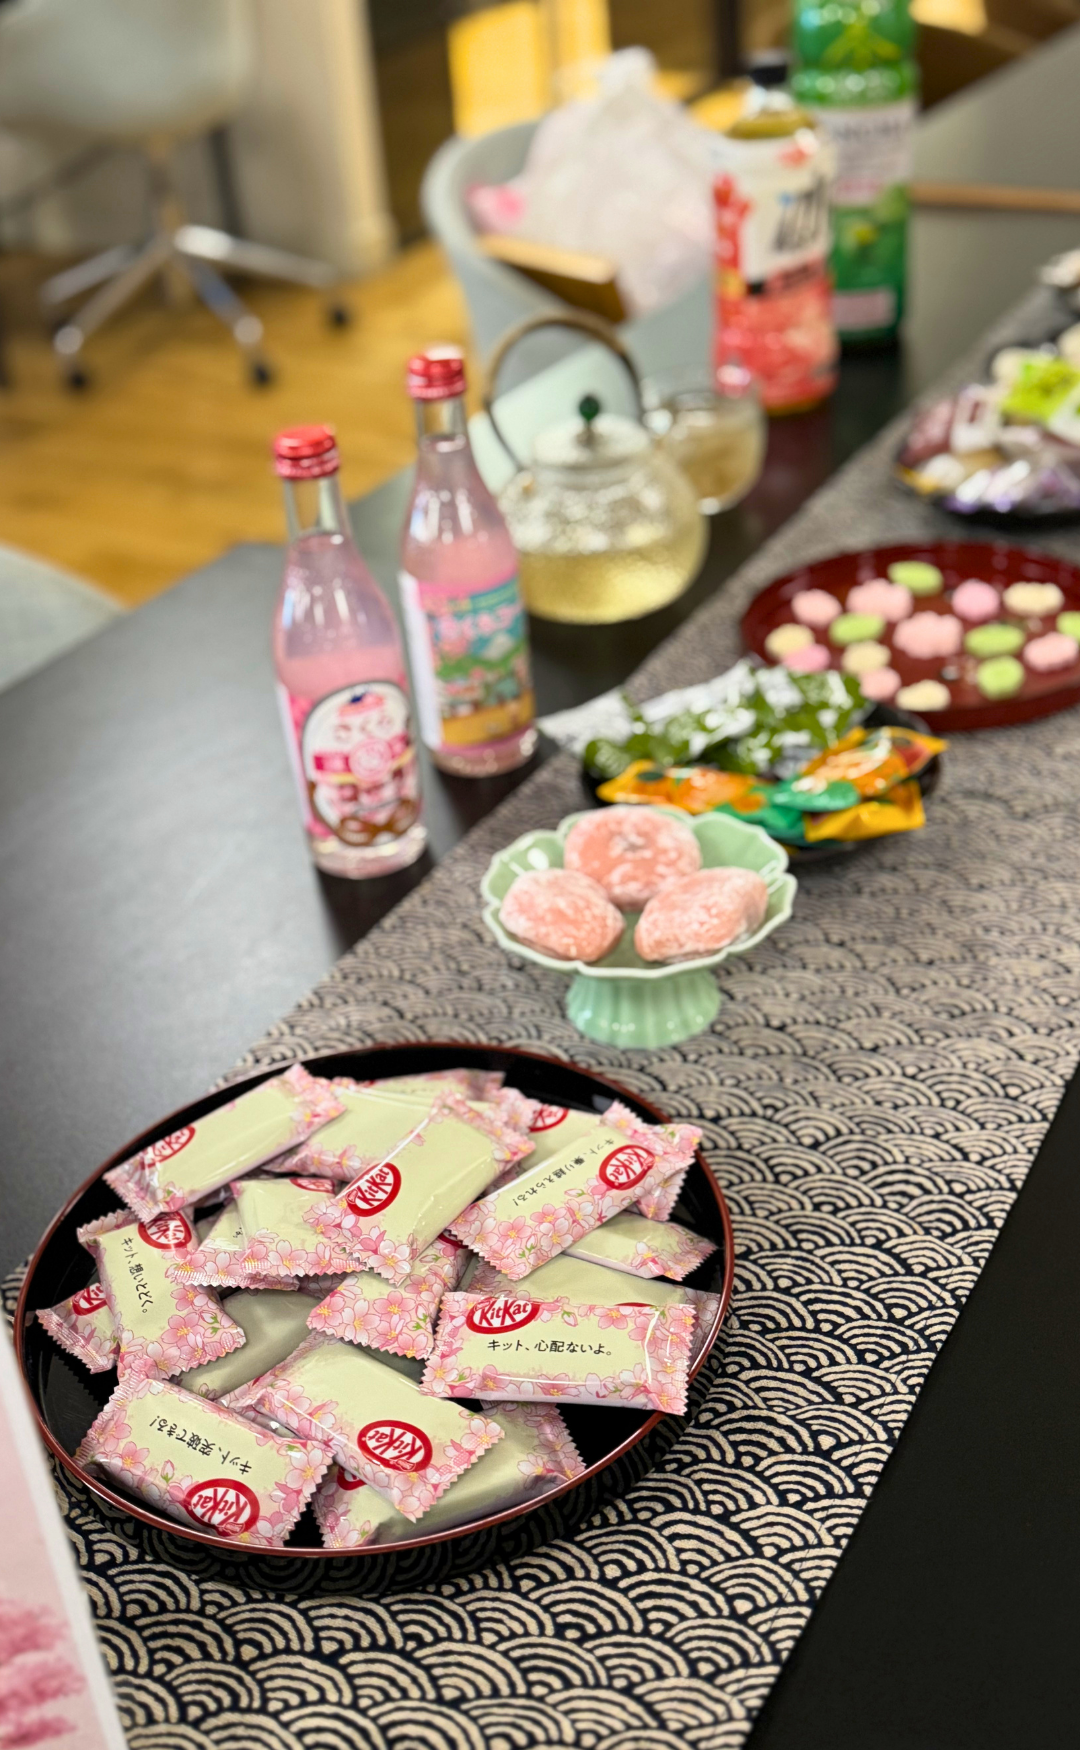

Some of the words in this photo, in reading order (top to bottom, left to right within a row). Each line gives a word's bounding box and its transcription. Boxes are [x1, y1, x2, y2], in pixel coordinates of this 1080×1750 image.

[608, 1149, 646, 1181] KitKat
[356, 1167, 393, 1208] KitKat
[121, 1237, 154, 1314] キット、想いとどく。
[479, 1299, 530, 1327] KitKat
[487, 1339, 612, 1356] キット、心配ないよ。
[149, 1415, 253, 1475] キット、突破できる!
[367, 1428, 423, 1460] KitKat
[193, 1488, 248, 1526] KitKat
